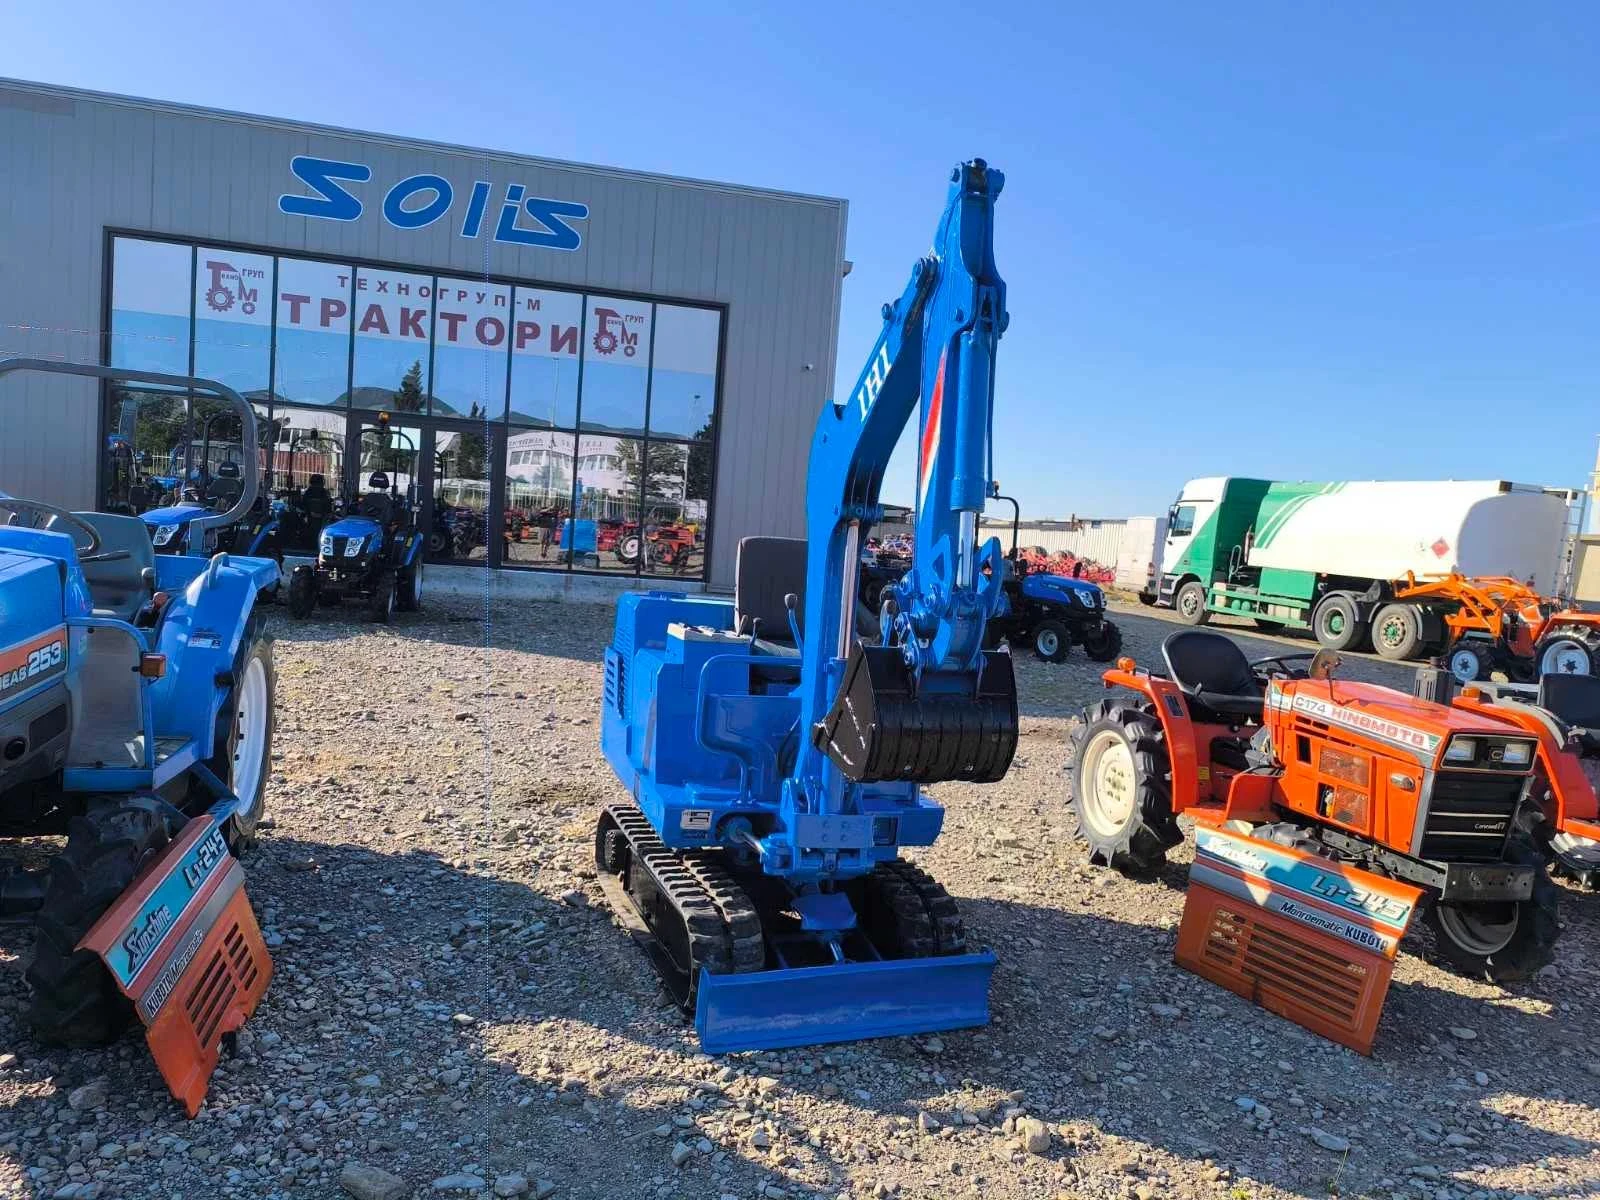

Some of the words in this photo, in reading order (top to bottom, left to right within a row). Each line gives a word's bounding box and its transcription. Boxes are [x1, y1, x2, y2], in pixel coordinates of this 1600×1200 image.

[241, 268, 264, 279] ГРУП
[281, 293, 579, 355] ТРАКТОРИ
[857, 339, 892, 423] IHI
[28, 640, 61, 678] 253
[1295, 697, 1327, 714] C174
[1331, 706, 1425, 747] HINOMOTO
[124, 904, 172, 974] Sunshine
[1280, 902, 1344, 935] Monroematic
[1344, 925, 1389, 951] KUBOTA
[145, 971, 174, 1018] KUBOTA
